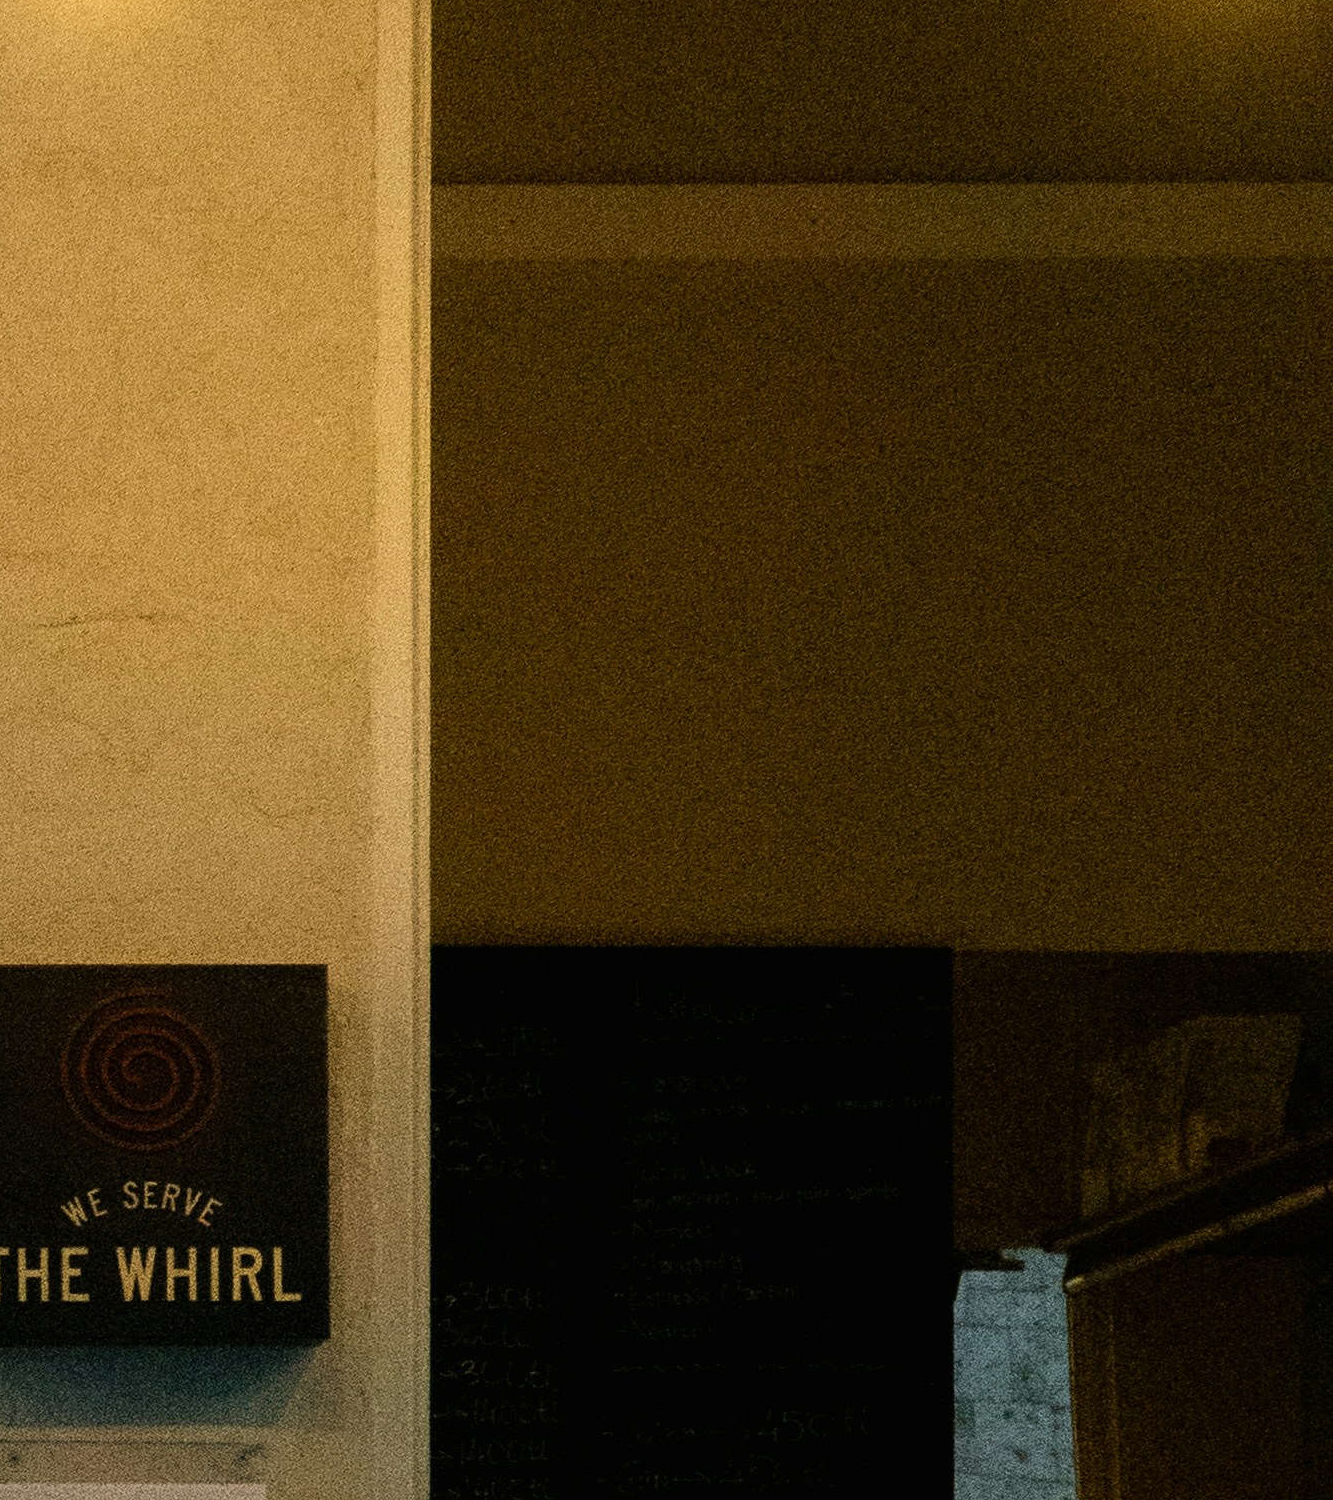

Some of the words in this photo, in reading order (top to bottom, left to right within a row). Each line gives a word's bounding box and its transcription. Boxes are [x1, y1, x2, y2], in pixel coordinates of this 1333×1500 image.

[60, 1188, 109, 1229] WE
[121, 1180, 224, 1228] SERVE
[115, 1246, 303, 1303] WHIRL
